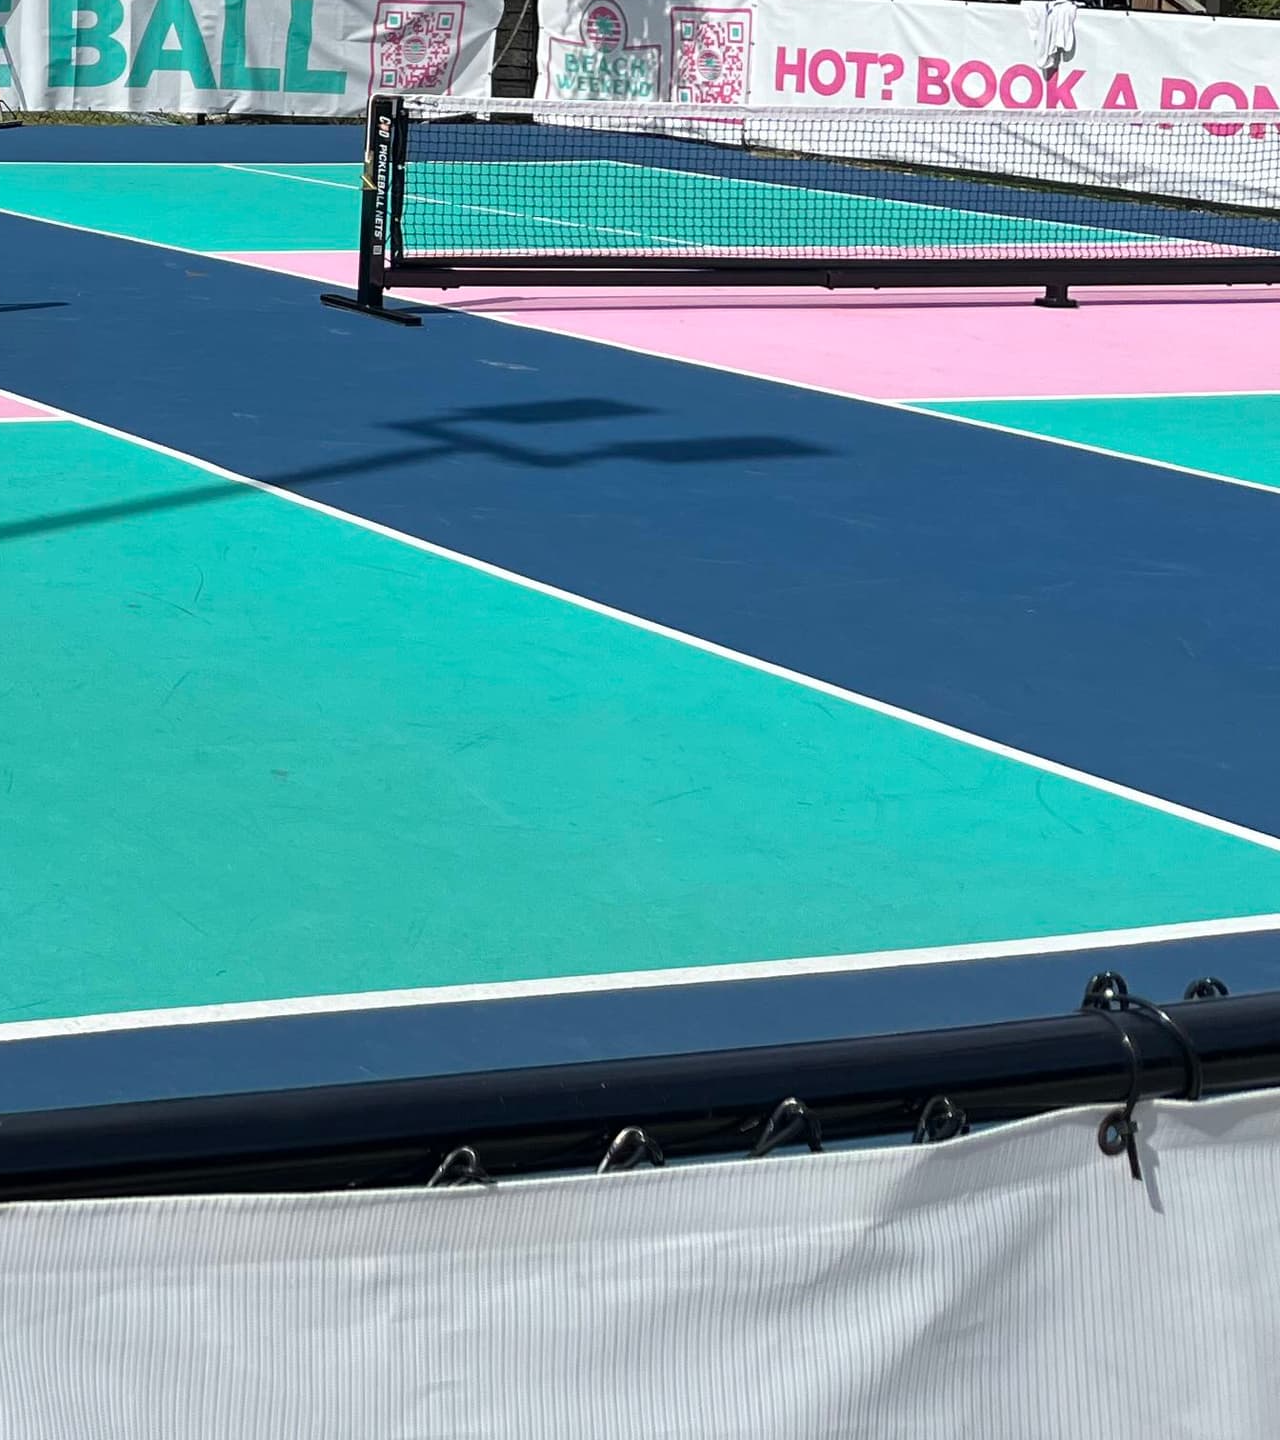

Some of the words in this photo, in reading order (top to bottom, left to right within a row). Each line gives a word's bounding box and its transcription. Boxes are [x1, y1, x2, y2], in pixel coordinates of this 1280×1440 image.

[565, 54, 645, 77] BEACH
[555, 75, 653, 97] WEEKEND
[776, 47, 903, 100] HOT?
[917, 56, 1086, 110] BOOK
[1103, 73, 1142, 126] A
[376, 144, 387, 207] PICKLEBALL
[374, 211, 384, 239] NETS
